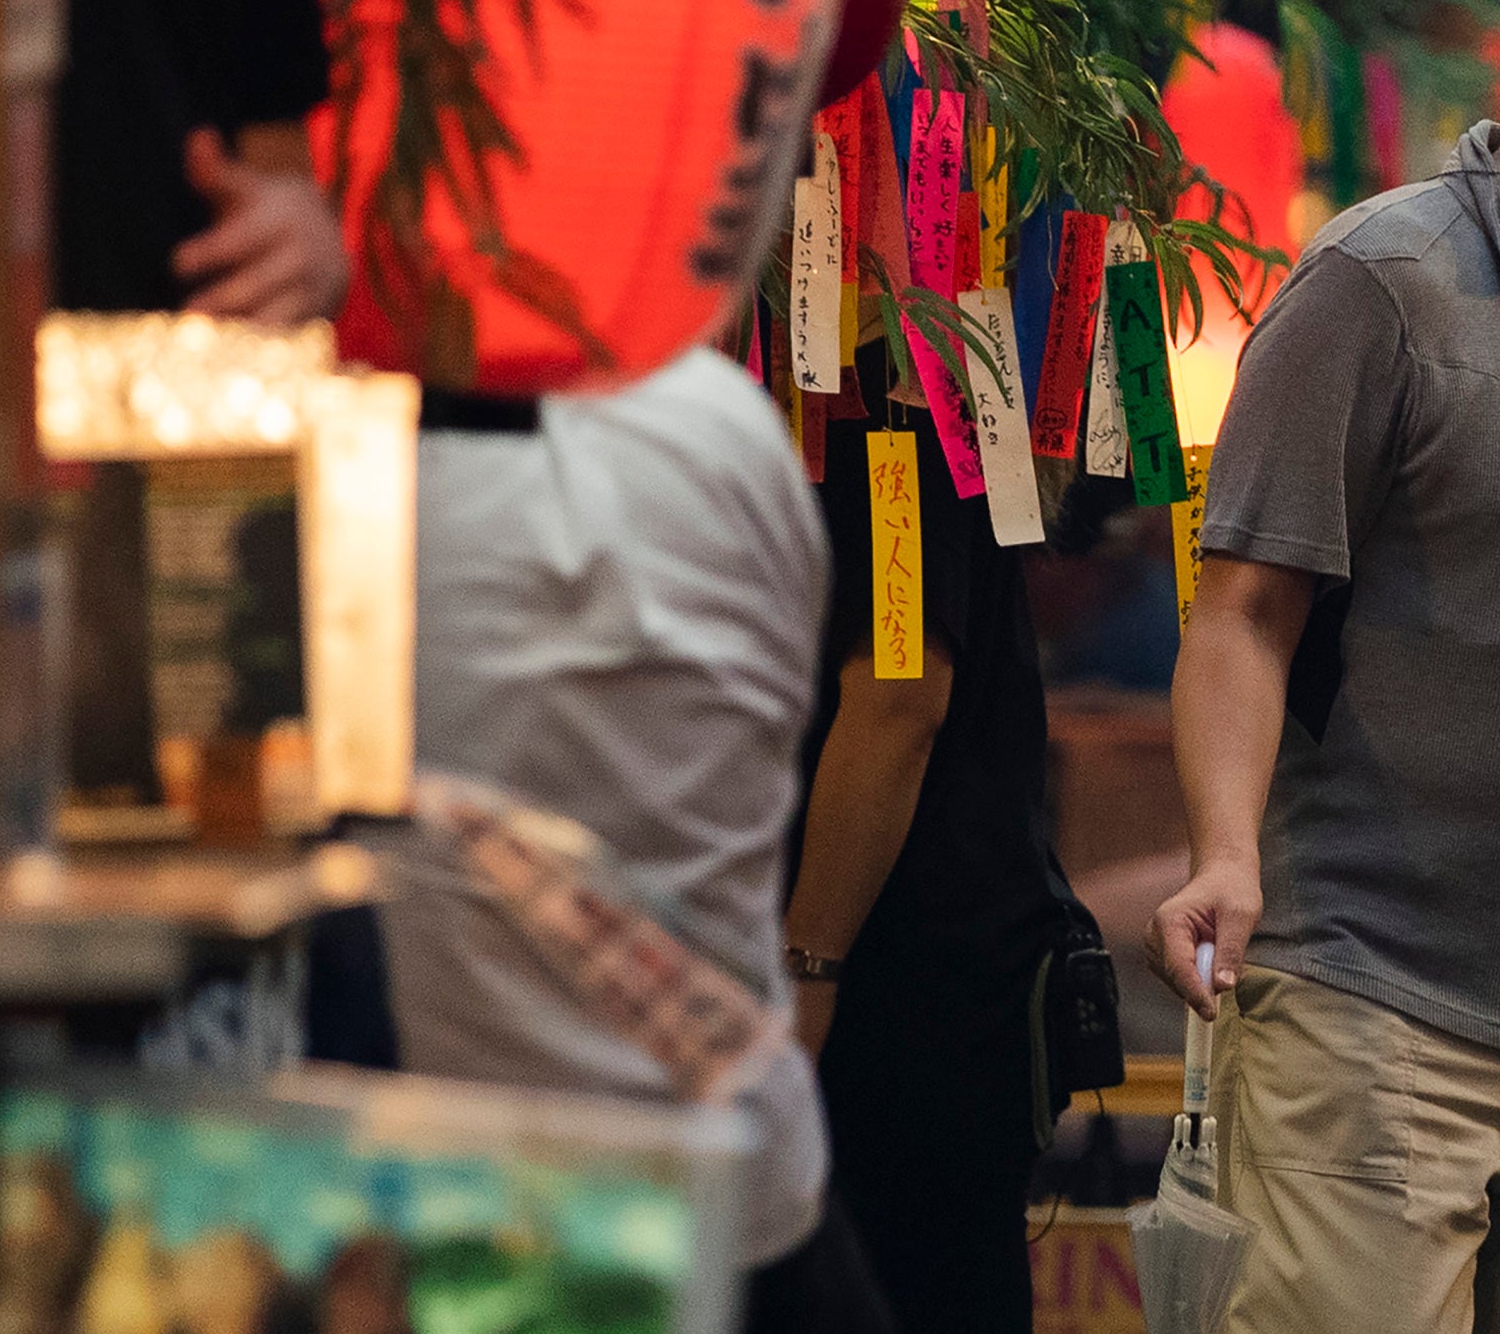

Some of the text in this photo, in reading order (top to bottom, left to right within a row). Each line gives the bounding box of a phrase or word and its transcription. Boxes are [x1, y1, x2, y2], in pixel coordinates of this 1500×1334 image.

[872, 460, 912, 671] 強い人になる
